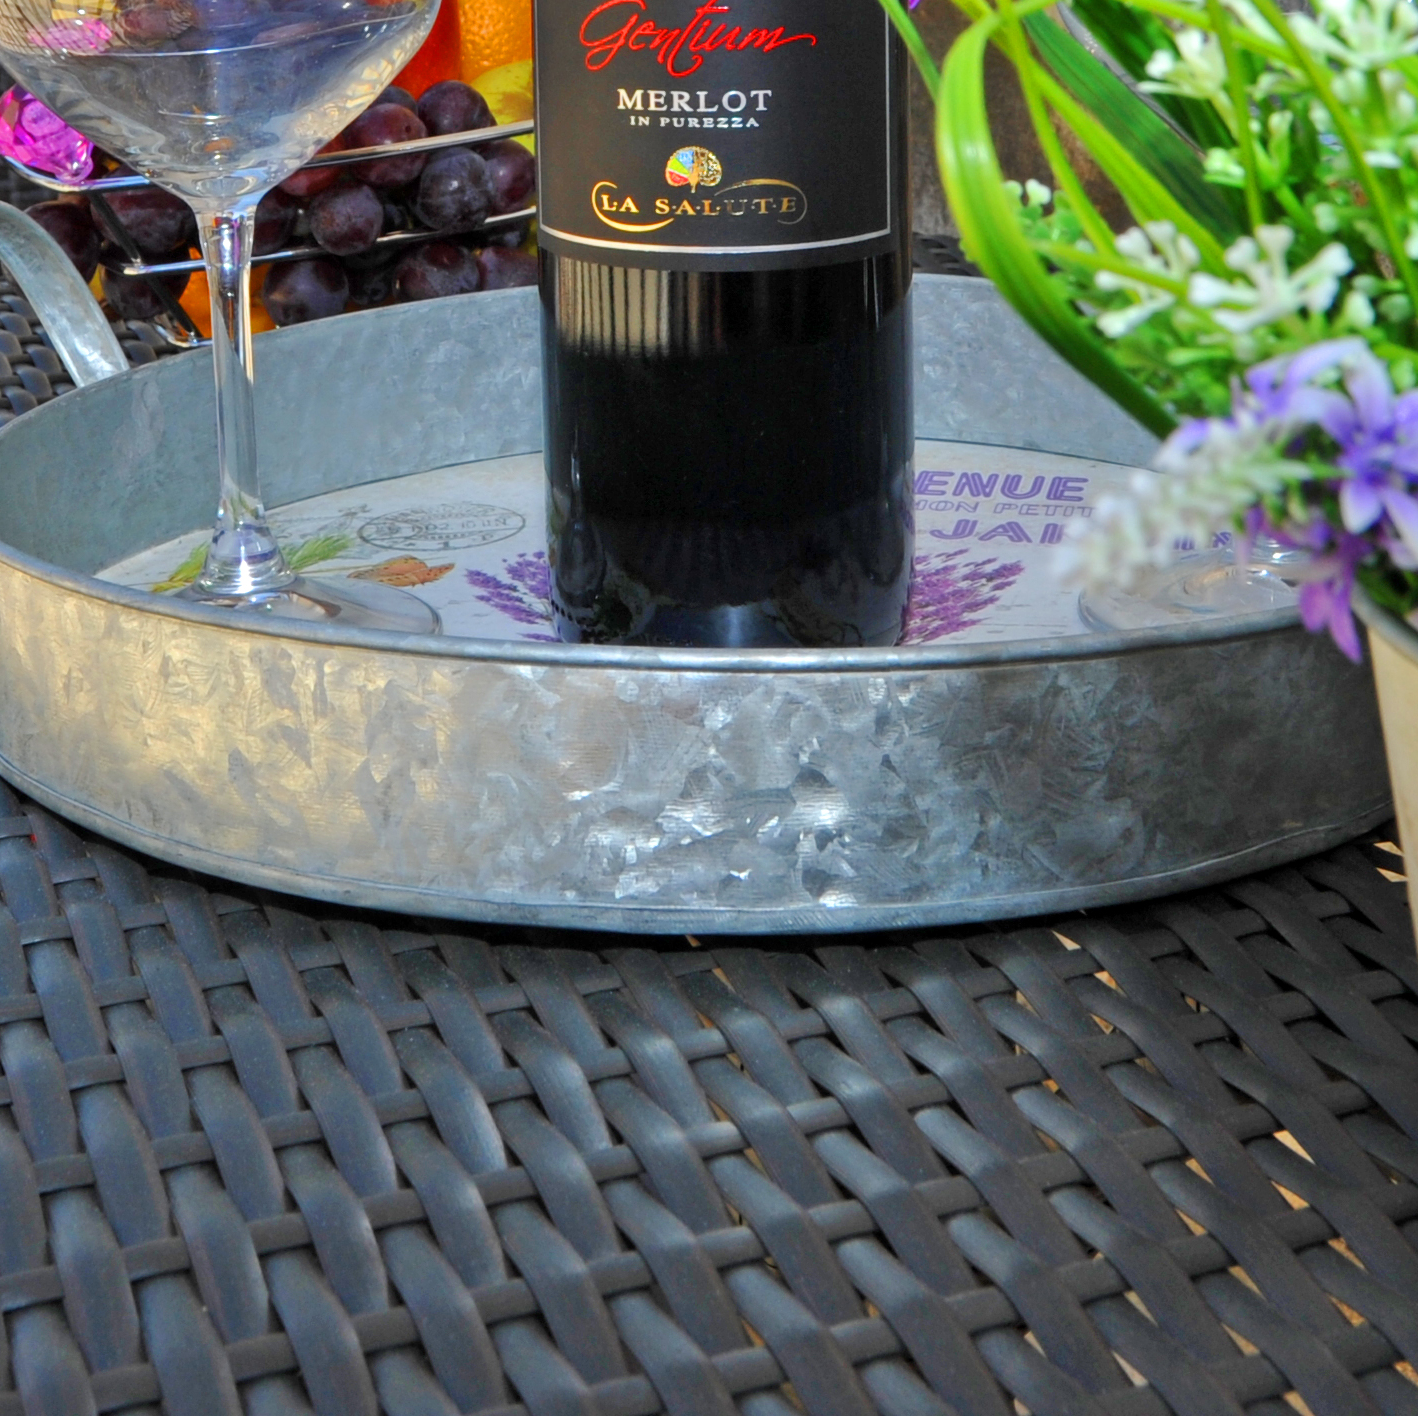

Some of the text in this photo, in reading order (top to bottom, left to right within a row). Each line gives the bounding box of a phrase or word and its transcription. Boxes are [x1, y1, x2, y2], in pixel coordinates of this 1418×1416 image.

[617, 88, 772, 112] MERLOT
[629, 115, 760, 129] IN PUREZZA
[992, 502, 1097, 518] PETIT
